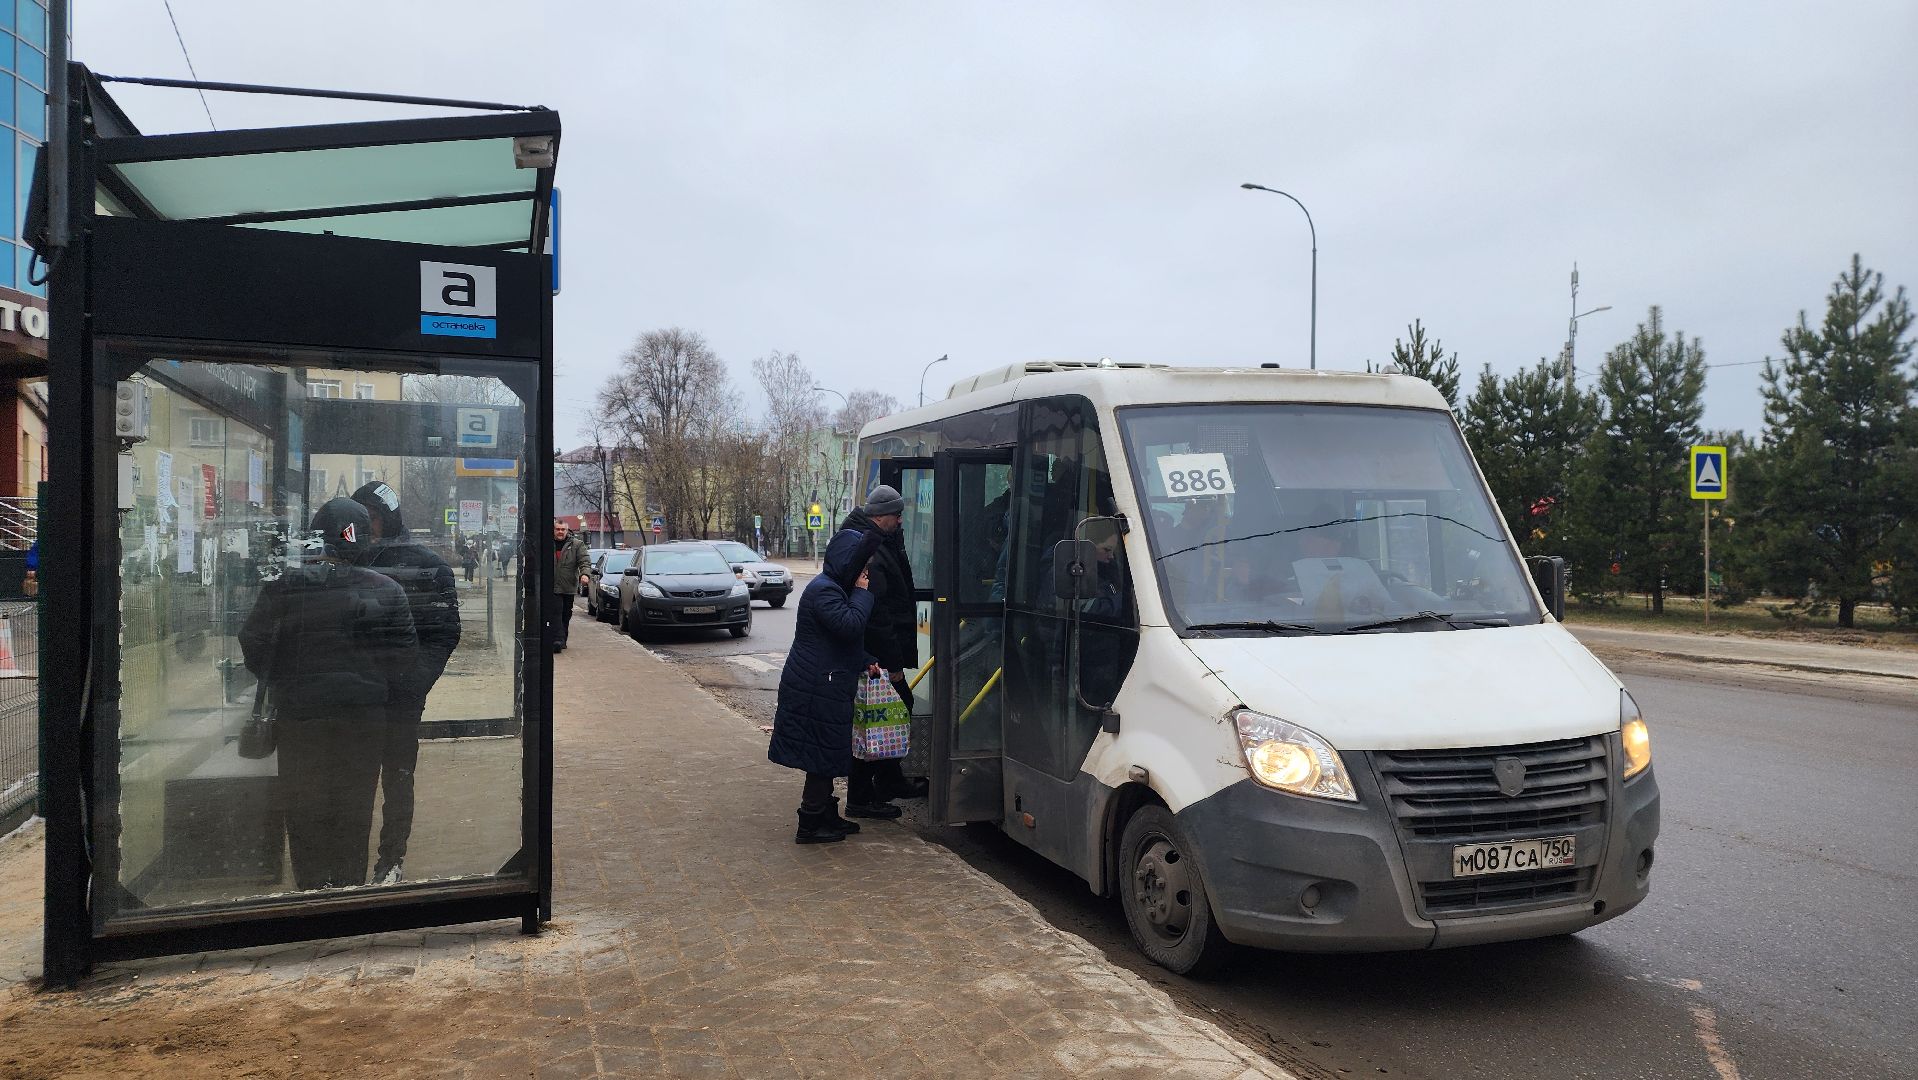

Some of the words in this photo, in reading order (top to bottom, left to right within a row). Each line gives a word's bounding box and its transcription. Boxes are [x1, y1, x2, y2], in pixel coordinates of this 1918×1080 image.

[431, 321, 486, 332] остановка
[1168, 468, 1226, 493] 886
[1542, 839, 1571, 859] 750
[1548, 856, 1563, 865] RUS
